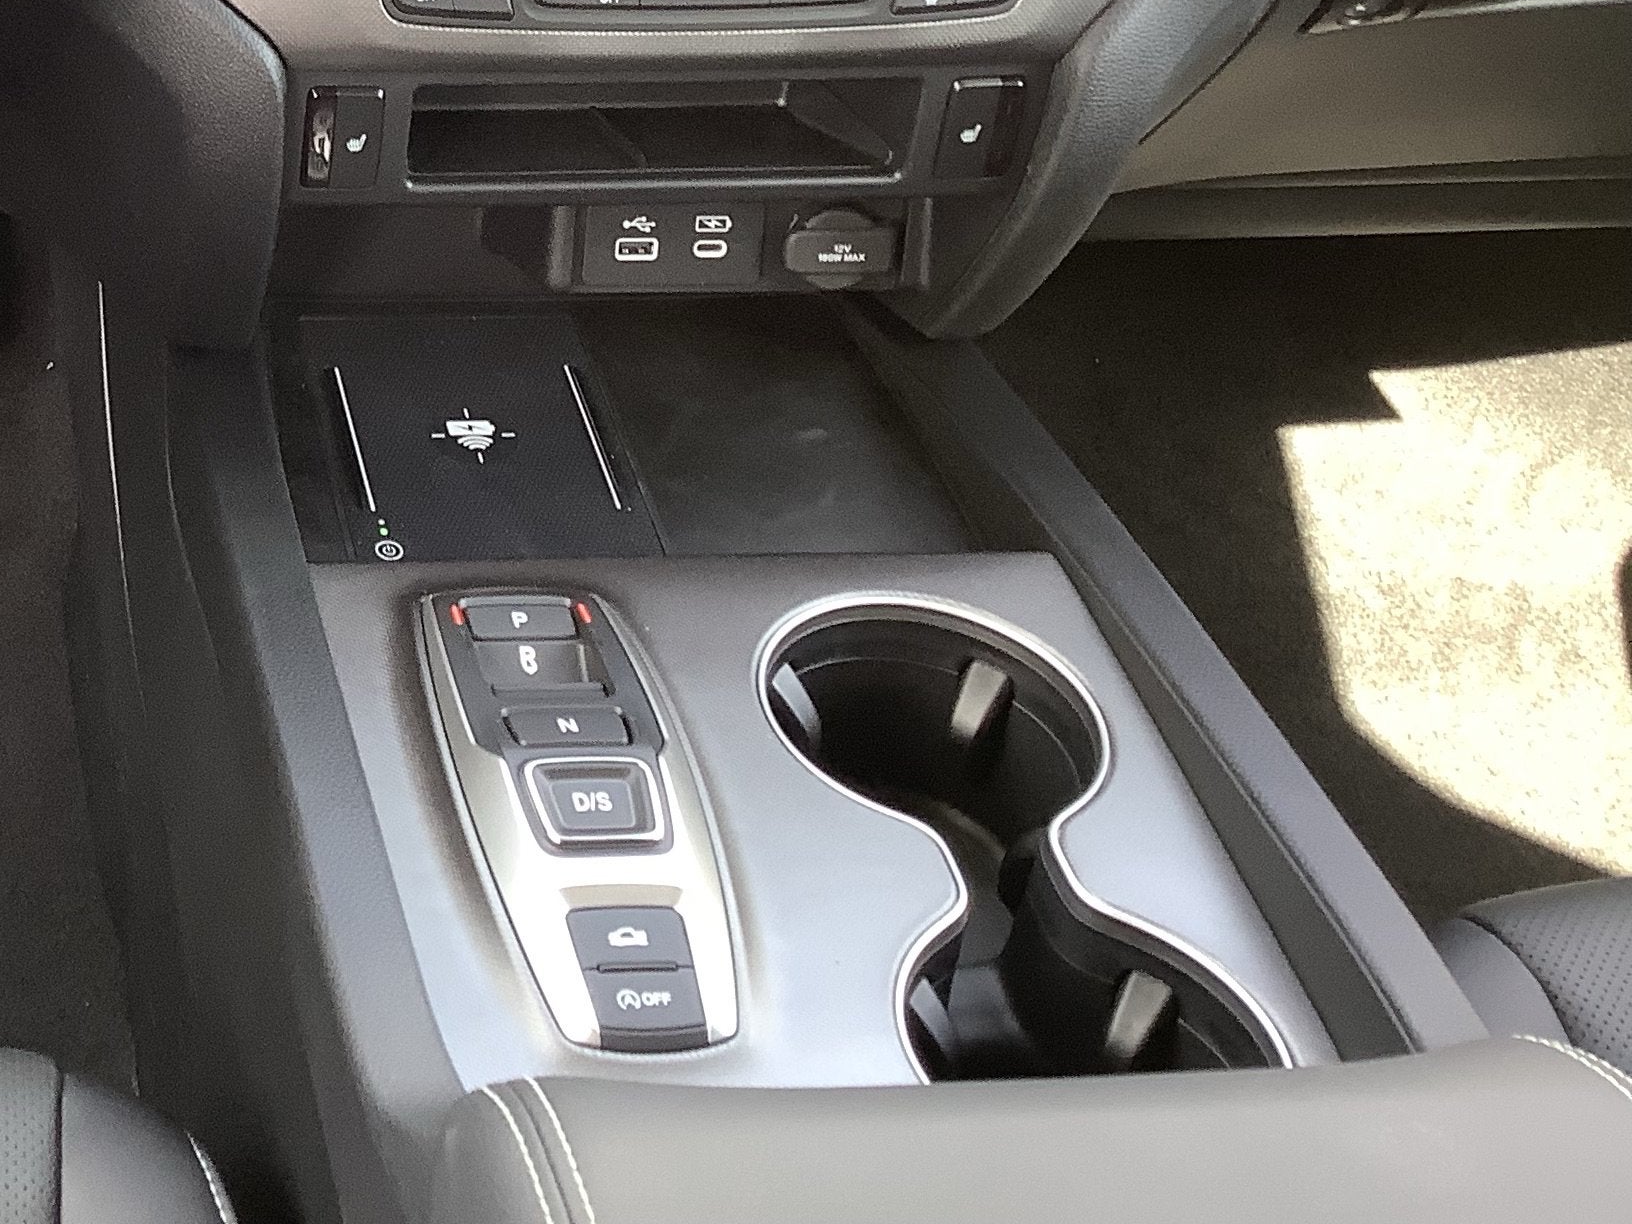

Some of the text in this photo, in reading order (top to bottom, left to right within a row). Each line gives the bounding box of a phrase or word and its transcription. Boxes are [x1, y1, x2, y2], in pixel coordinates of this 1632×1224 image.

[843, 253, 866, 262] MAX
[511, 611, 528, 628] P
[556, 717, 580, 733] N
[572, 790, 614, 813] D/S
[641, 990, 671, 1007] OFF
